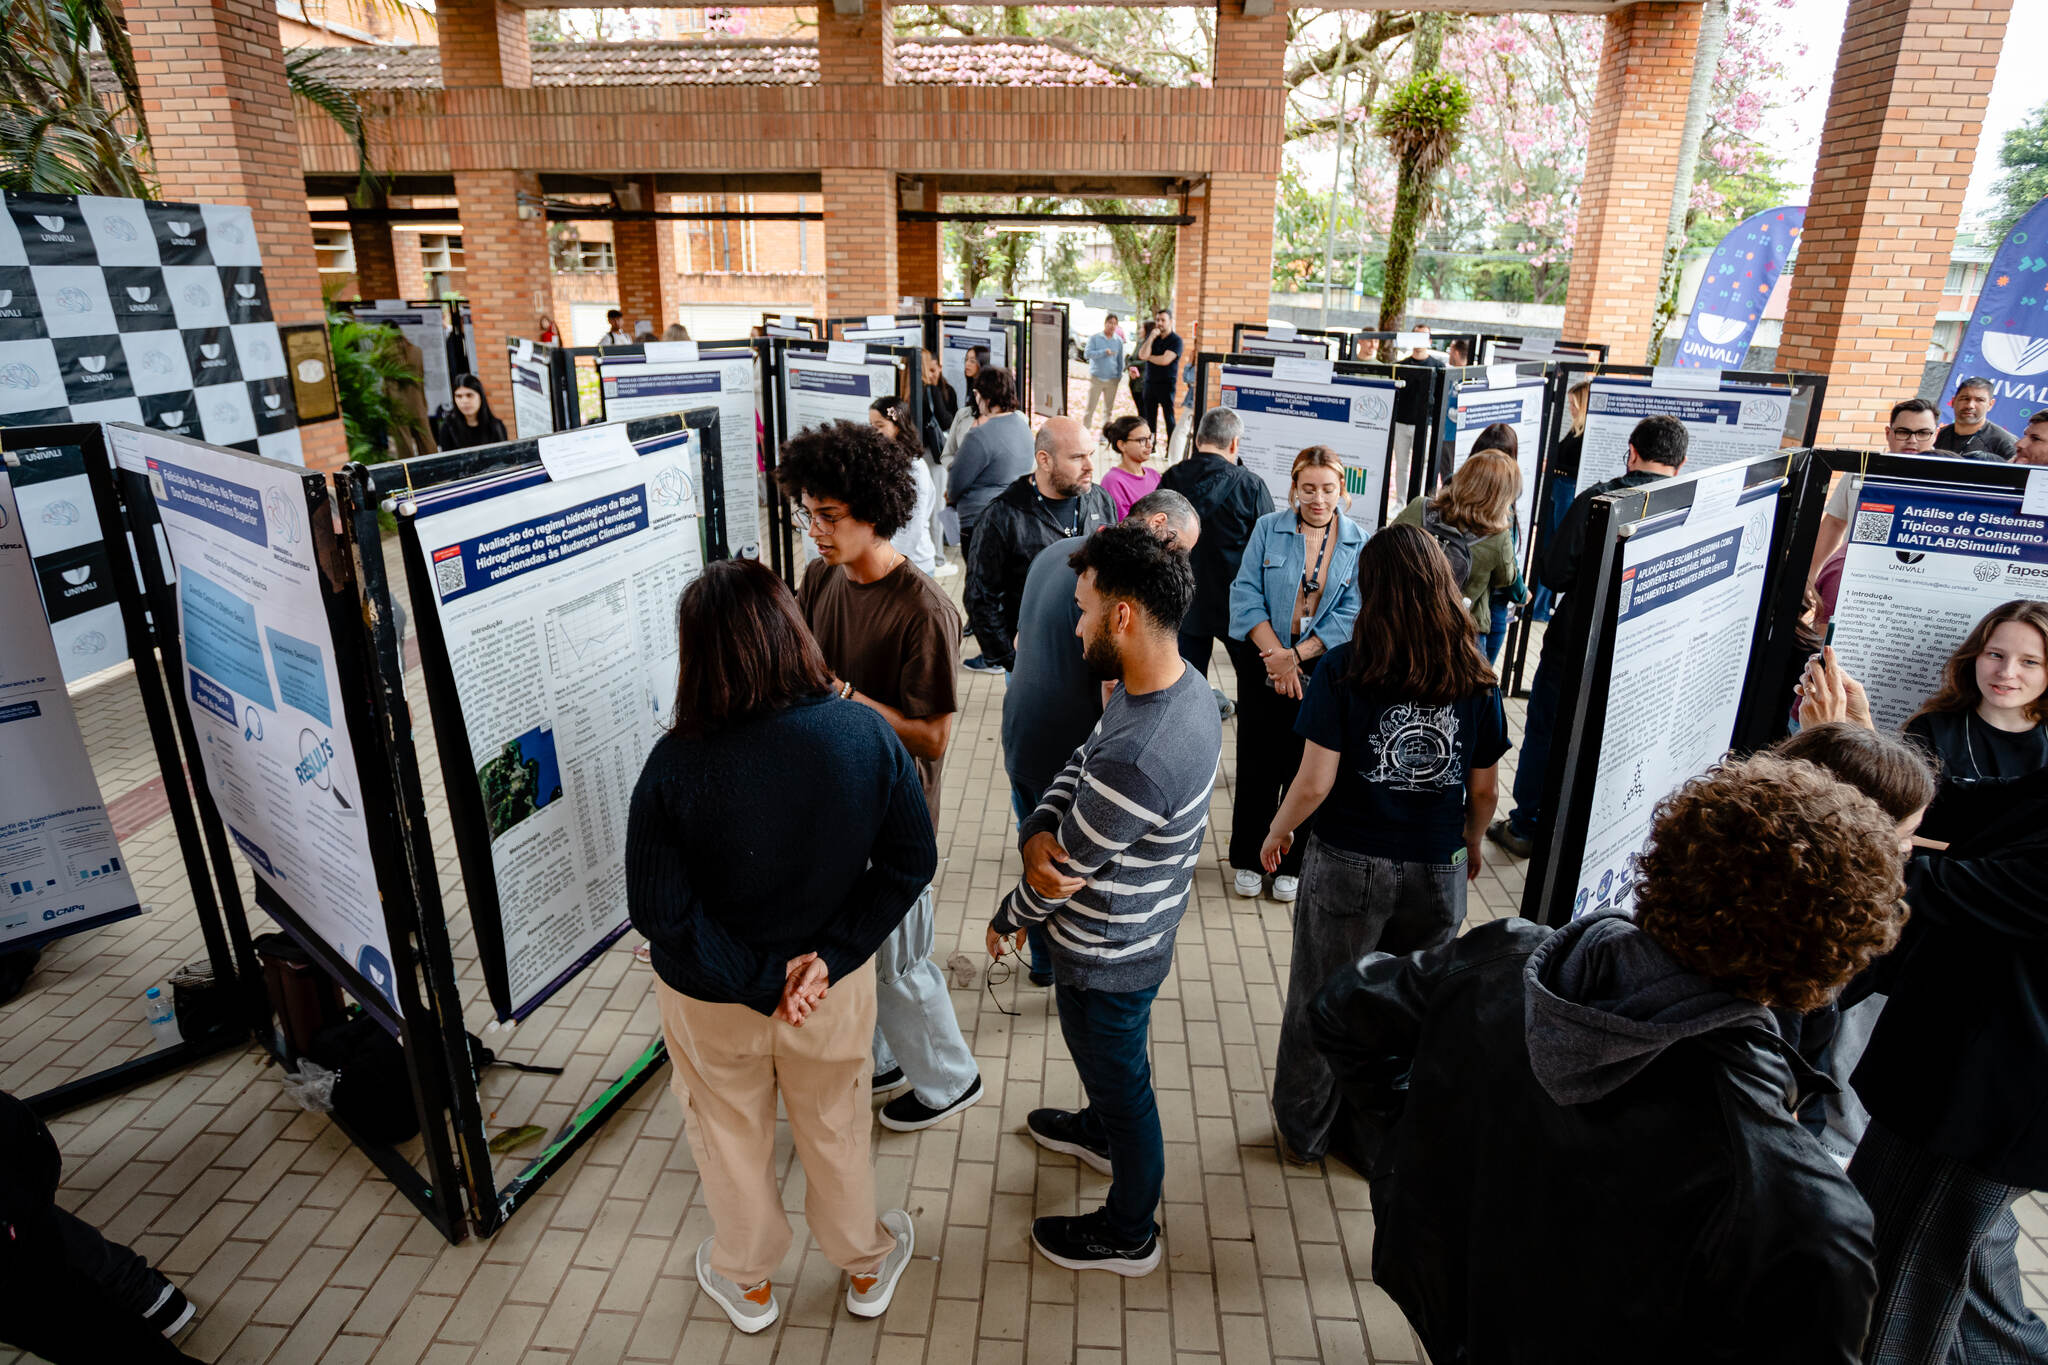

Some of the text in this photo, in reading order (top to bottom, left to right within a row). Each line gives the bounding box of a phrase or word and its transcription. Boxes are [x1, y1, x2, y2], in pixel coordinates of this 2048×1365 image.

[41, 234, 75, 243] UNIVALI
[171, 237, 196, 246] UNIVALI
[129, 303, 158, 312] UNIVALI
[1683, 341, 1740, 366] UNIVALI
[82, 373, 113, 383] UNIVALI
[26, 449, 62, 462] UNIVALI
[163, 469, 259, 510] Felicidade No Trabalho Na Percepção
[477, 492, 639, 556] Avaliação do regime hidrológico da Bacia
[1902, 505, 2044, 529] Análise de Sistemas
[476, 542, 531, 571] Hidrográfica
[532, 538, 544, 551] do
[546, 532, 561, 546] Rio
[562, 520, 597, 541] Camboriú
[605, 505, 642, 525] tendências
[1900, 519, 2043, 543] Típicos de Consumo
[490, 519, 636, 580] relacionadas às Mudanças Climáticas
[1896, 532, 2020, 556] MATLAB/Simulink
[1637, 535, 1734, 581] APLICAÇÃO DE ESCAMA DE SARDINHA COMO
[1888, 563, 1925, 574] UNIVALI
[1635, 553, 1716, 593] ADSORVENTE SUSTENTÁVEL PARA O
[63, 582, 98, 597] UNIVALI
[1851, 590, 1892, 601] Introdução
[295, 737, 334, 786] RESULTS
[56, 903, 85, 916] CNPq
